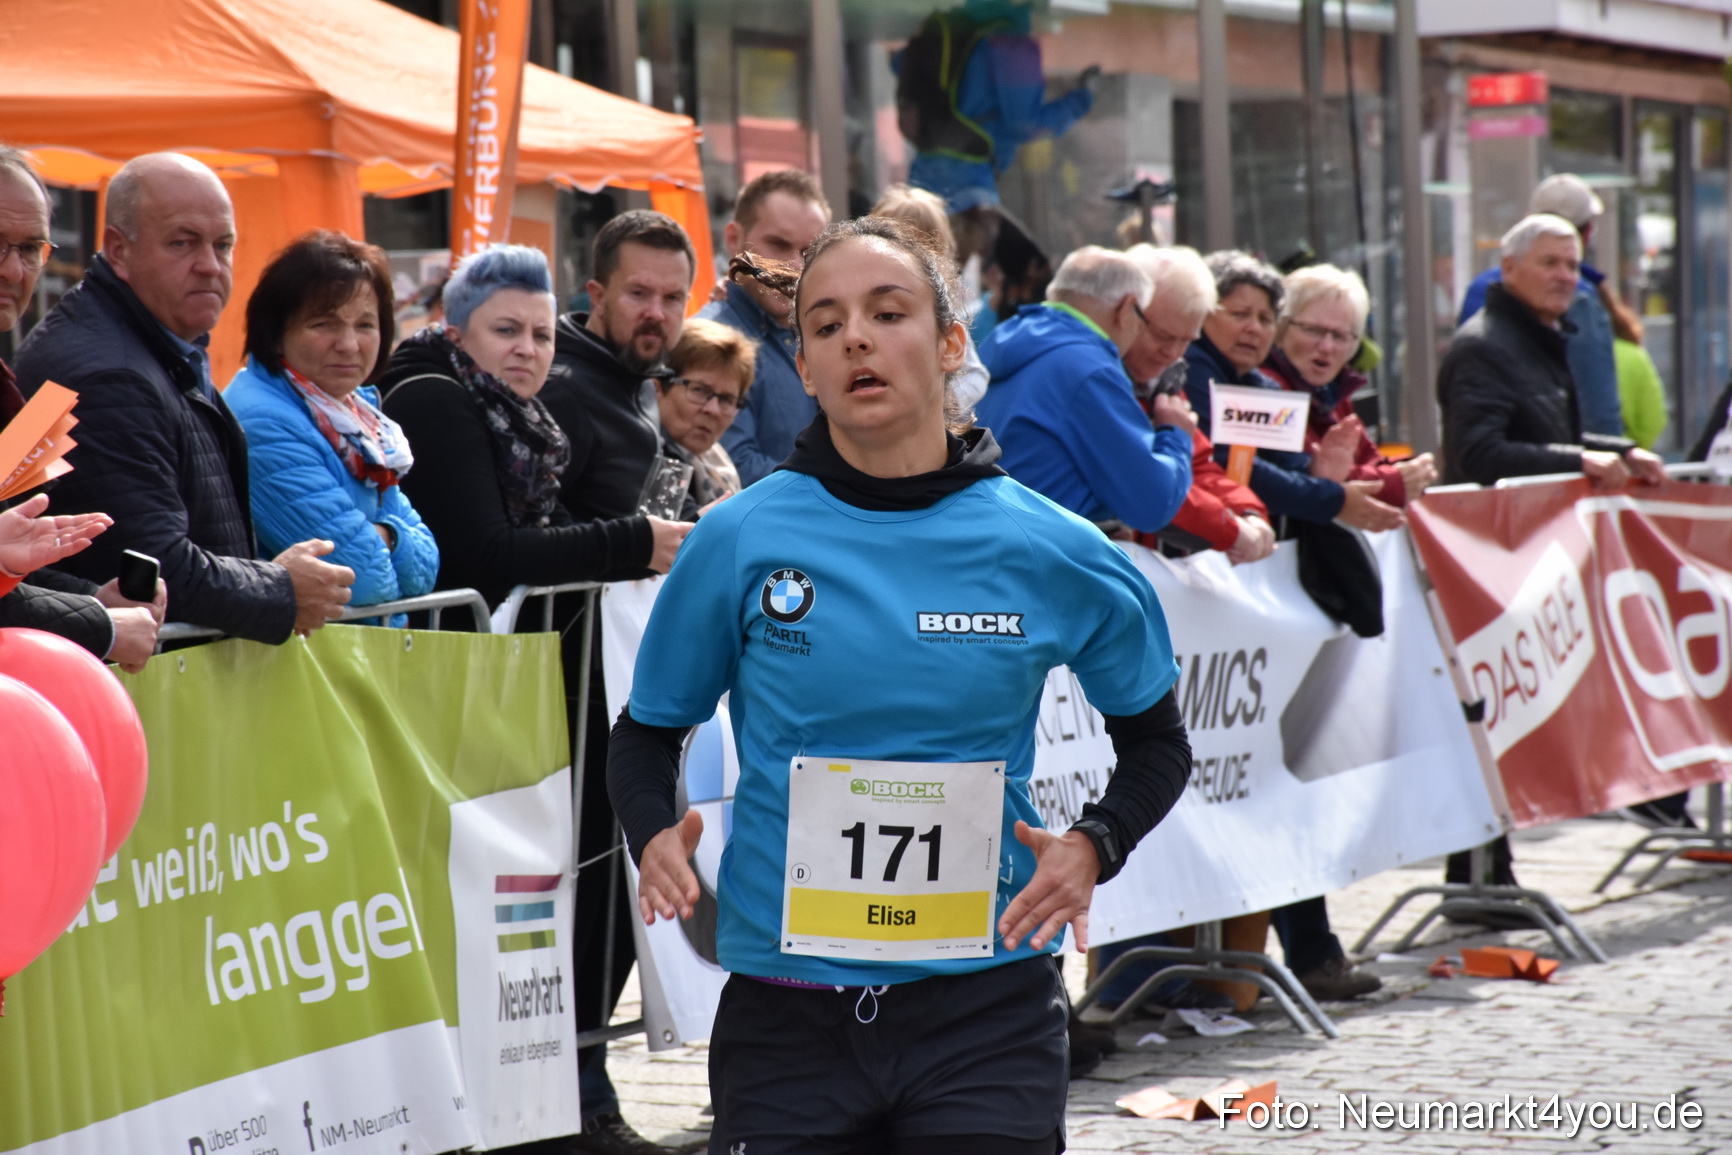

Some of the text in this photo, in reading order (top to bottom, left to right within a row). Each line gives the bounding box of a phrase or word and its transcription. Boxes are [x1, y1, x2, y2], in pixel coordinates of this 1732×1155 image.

[1223, 408, 1271, 425] swn
[766, 570, 811, 589] BMW
[764, 622, 812, 646] PARTL
[917, 612, 1026, 638] BOCK
[763, 636, 811, 656] Neumarkt
[917, 635, 952, 644] inspired
[953, 637, 964, 645] by
[993, 638, 1029, 646] concepts
[1174, 647, 1267, 731] MICS.
[1472, 629, 1540, 731] DAS
[872, 780, 945, 798] BOCK
[1027, 752, 1252, 829] BRAUCH REUDE.
[131, 822, 224, 908] weiß,
[229, 800, 328, 882] wo's
[841, 821, 942, 881] 171
[797, 868, 805, 879] D
[867, 904, 916, 926] Elisa
[205, 866, 424, 1006] langge
[207, 1128, 239, 1152] über
[240, 1114, 267, 1142] 500
